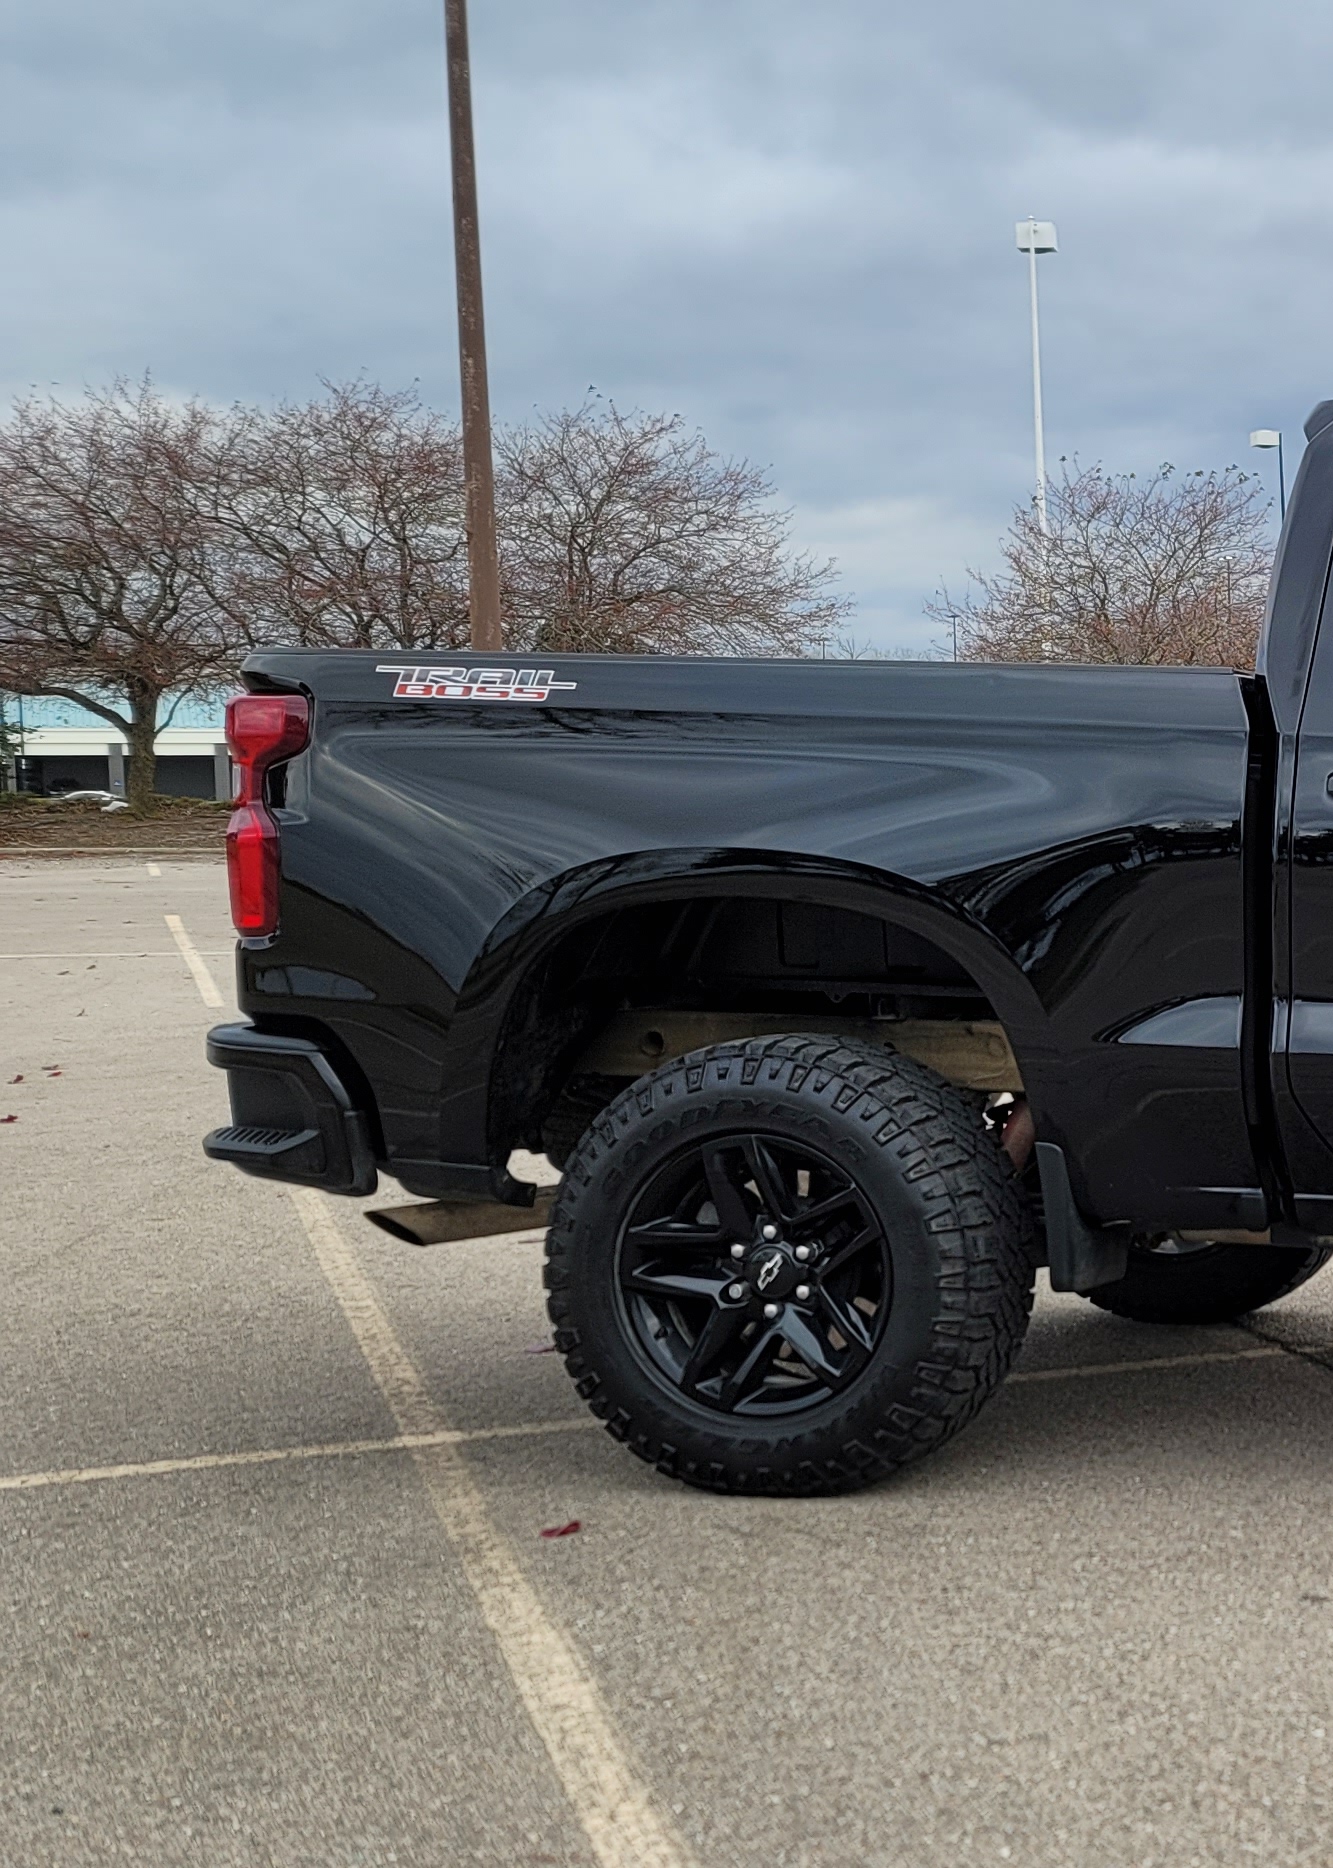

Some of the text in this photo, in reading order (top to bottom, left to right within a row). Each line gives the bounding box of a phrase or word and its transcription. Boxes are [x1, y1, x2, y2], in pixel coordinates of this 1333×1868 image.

[376, 665, 576, 689] TRAIL
[394, 683, 549, 702] BOSS
[603, 1098, 867, 1197] GOODYEAR
